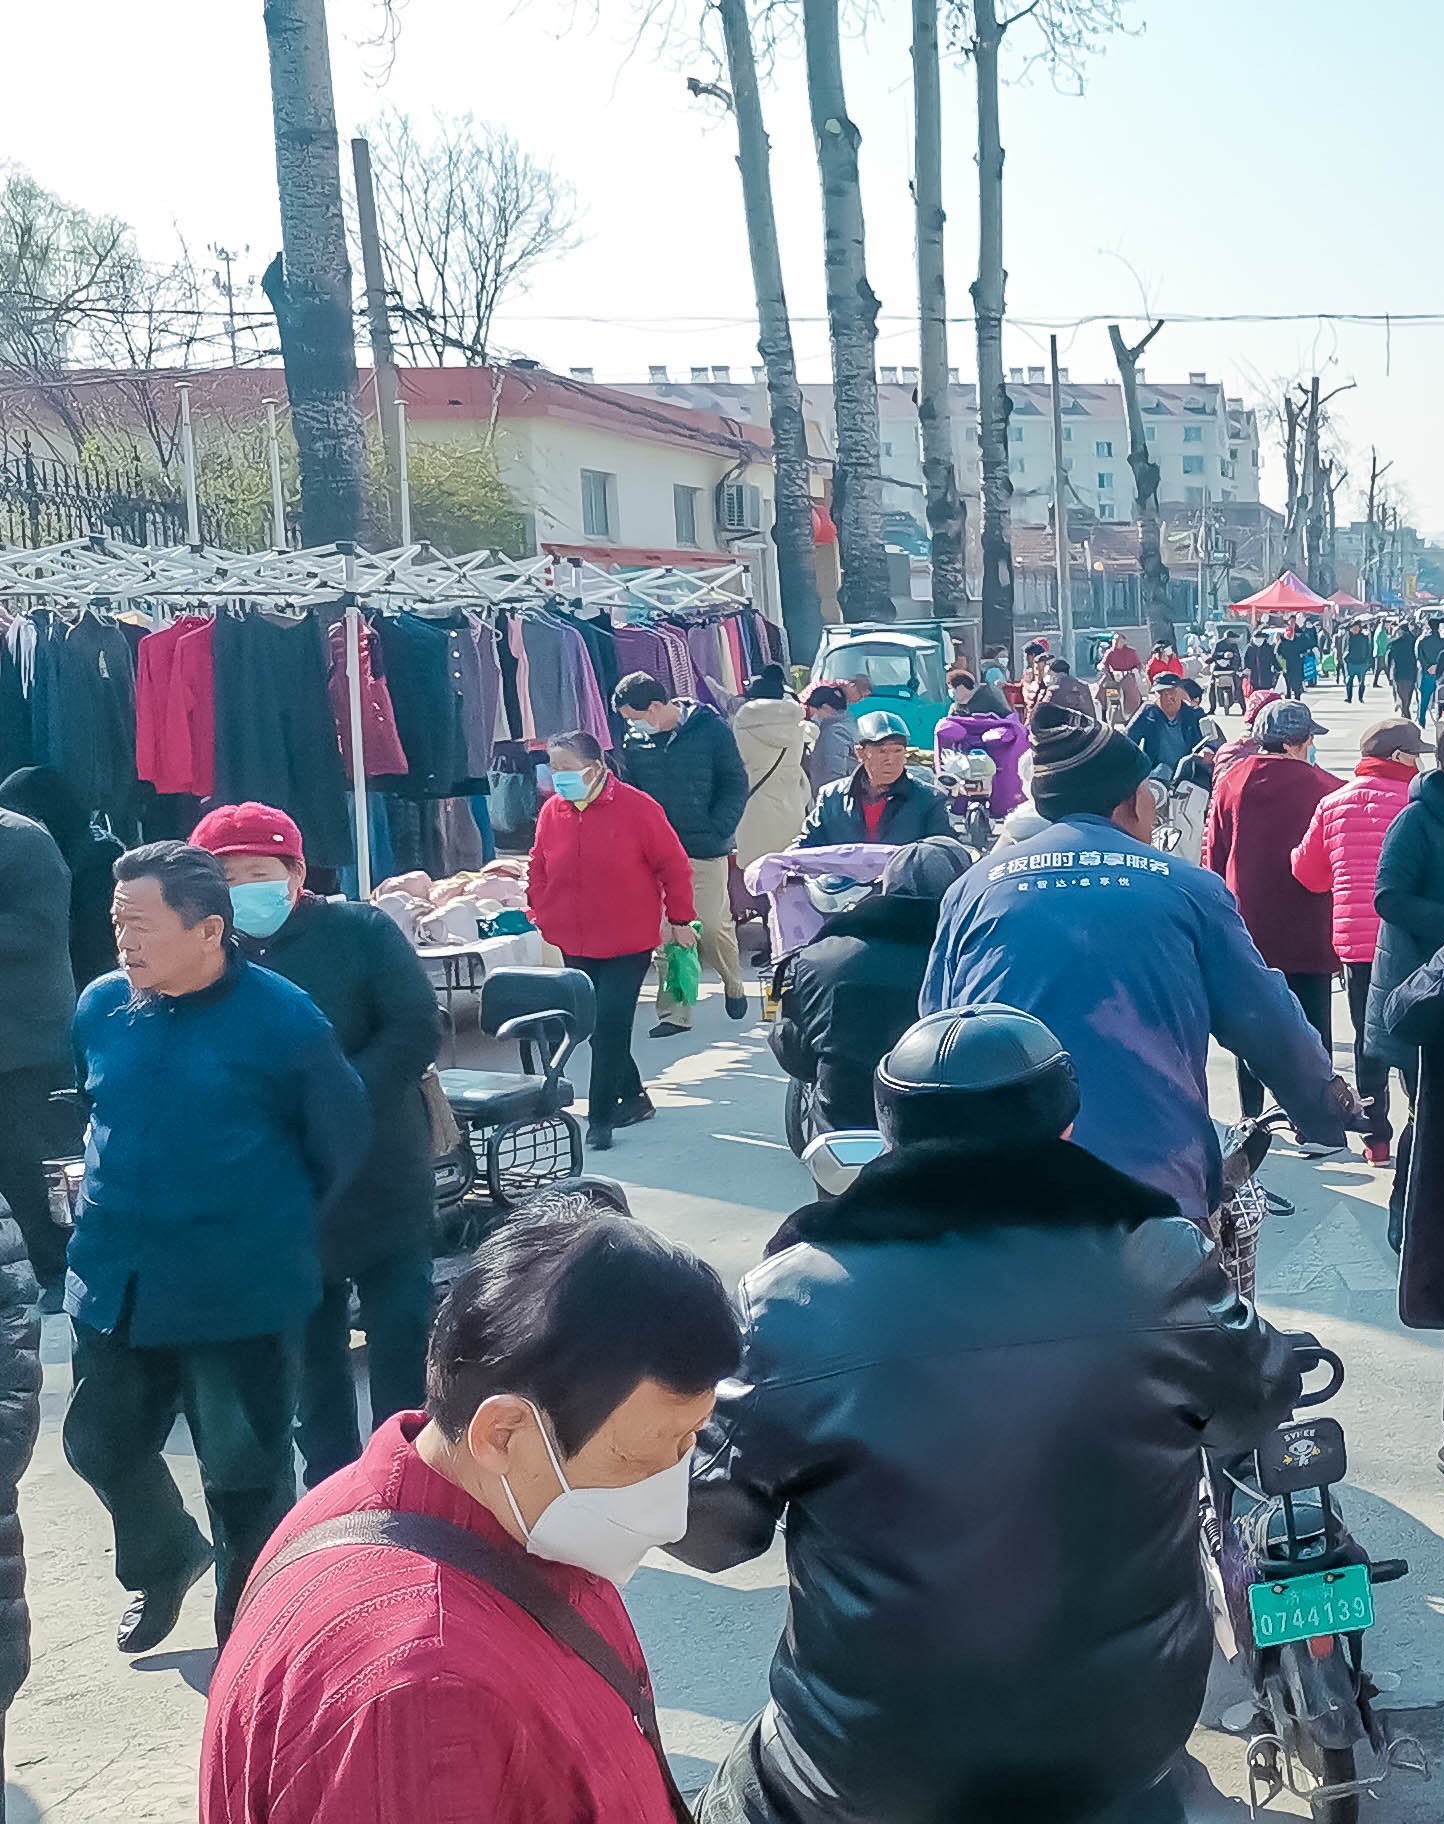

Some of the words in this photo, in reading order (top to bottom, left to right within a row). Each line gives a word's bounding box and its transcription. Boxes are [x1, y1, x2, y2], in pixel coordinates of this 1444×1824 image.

[987, 851, 1075, 881] 老板即时
[1078, 850, 1170, 876] 尊享服务
[1260, 1596, 1366, 1636] 0744139
